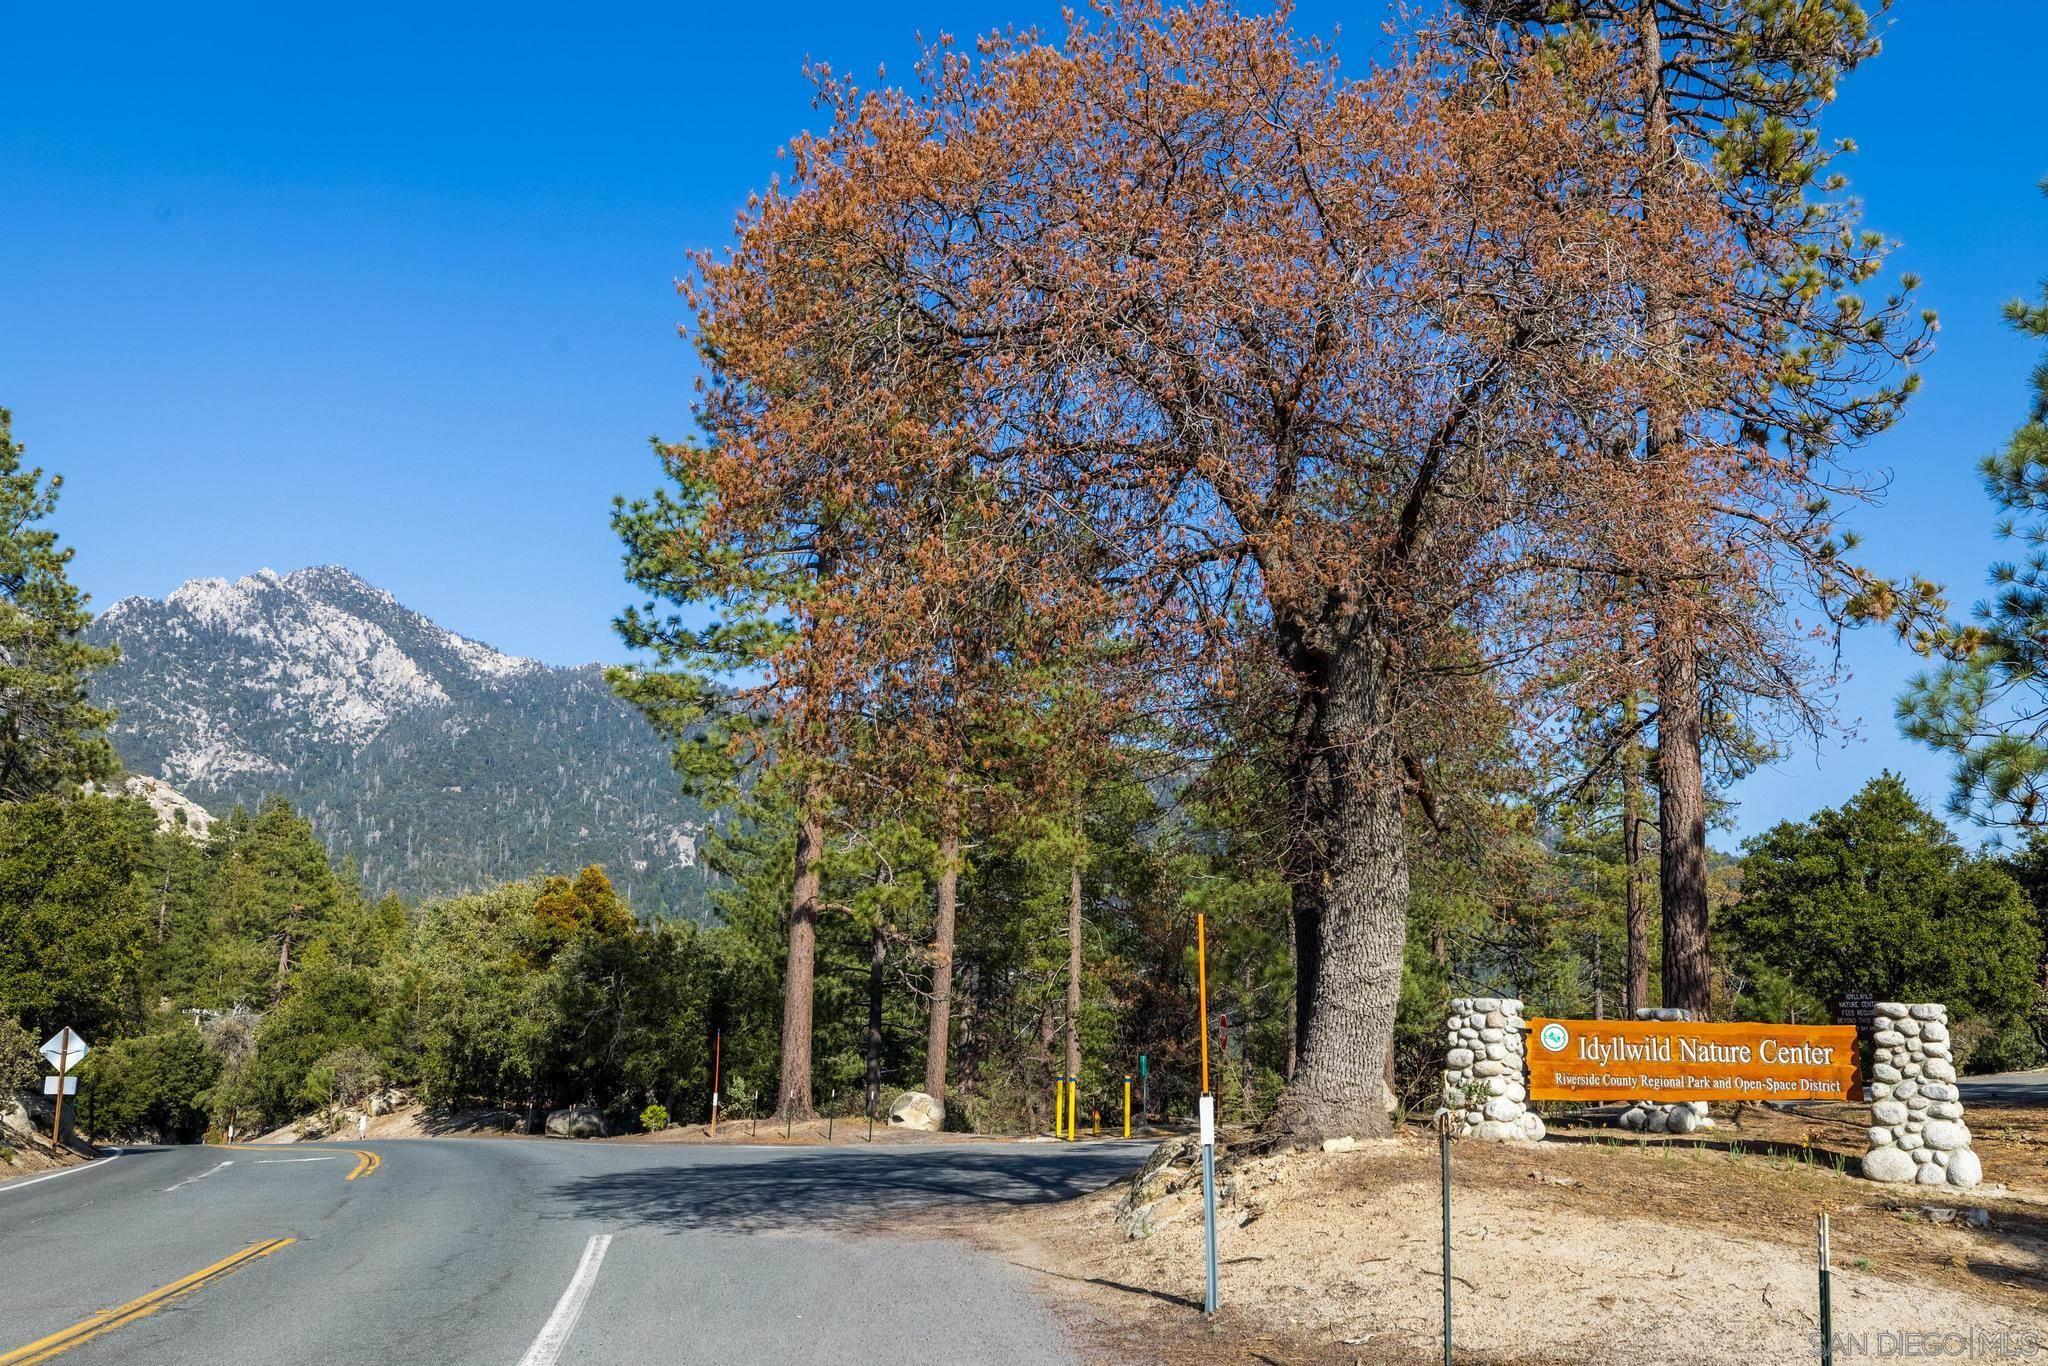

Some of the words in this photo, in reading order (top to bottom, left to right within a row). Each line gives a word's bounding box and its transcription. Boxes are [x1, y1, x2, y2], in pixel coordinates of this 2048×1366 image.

[1579, 1036, 1671, 1066] Idyllwild
[1679, 1038, 1752, 1064] Nature
[1759, 1039, 1834, 1065] Center
[1555, 1072, 1600, 1085] Riverside
[1602, 1073, 1637, 1088] County
[1641, 1075, 1685, 1089] Regional
[1688, 1076, 1710, 1088] Park
[1713, 1077, 1731, 1089] and
[1734, 1078, 1797, 1092] Open-Space
[1800, 1079, 1841, 1092] District
